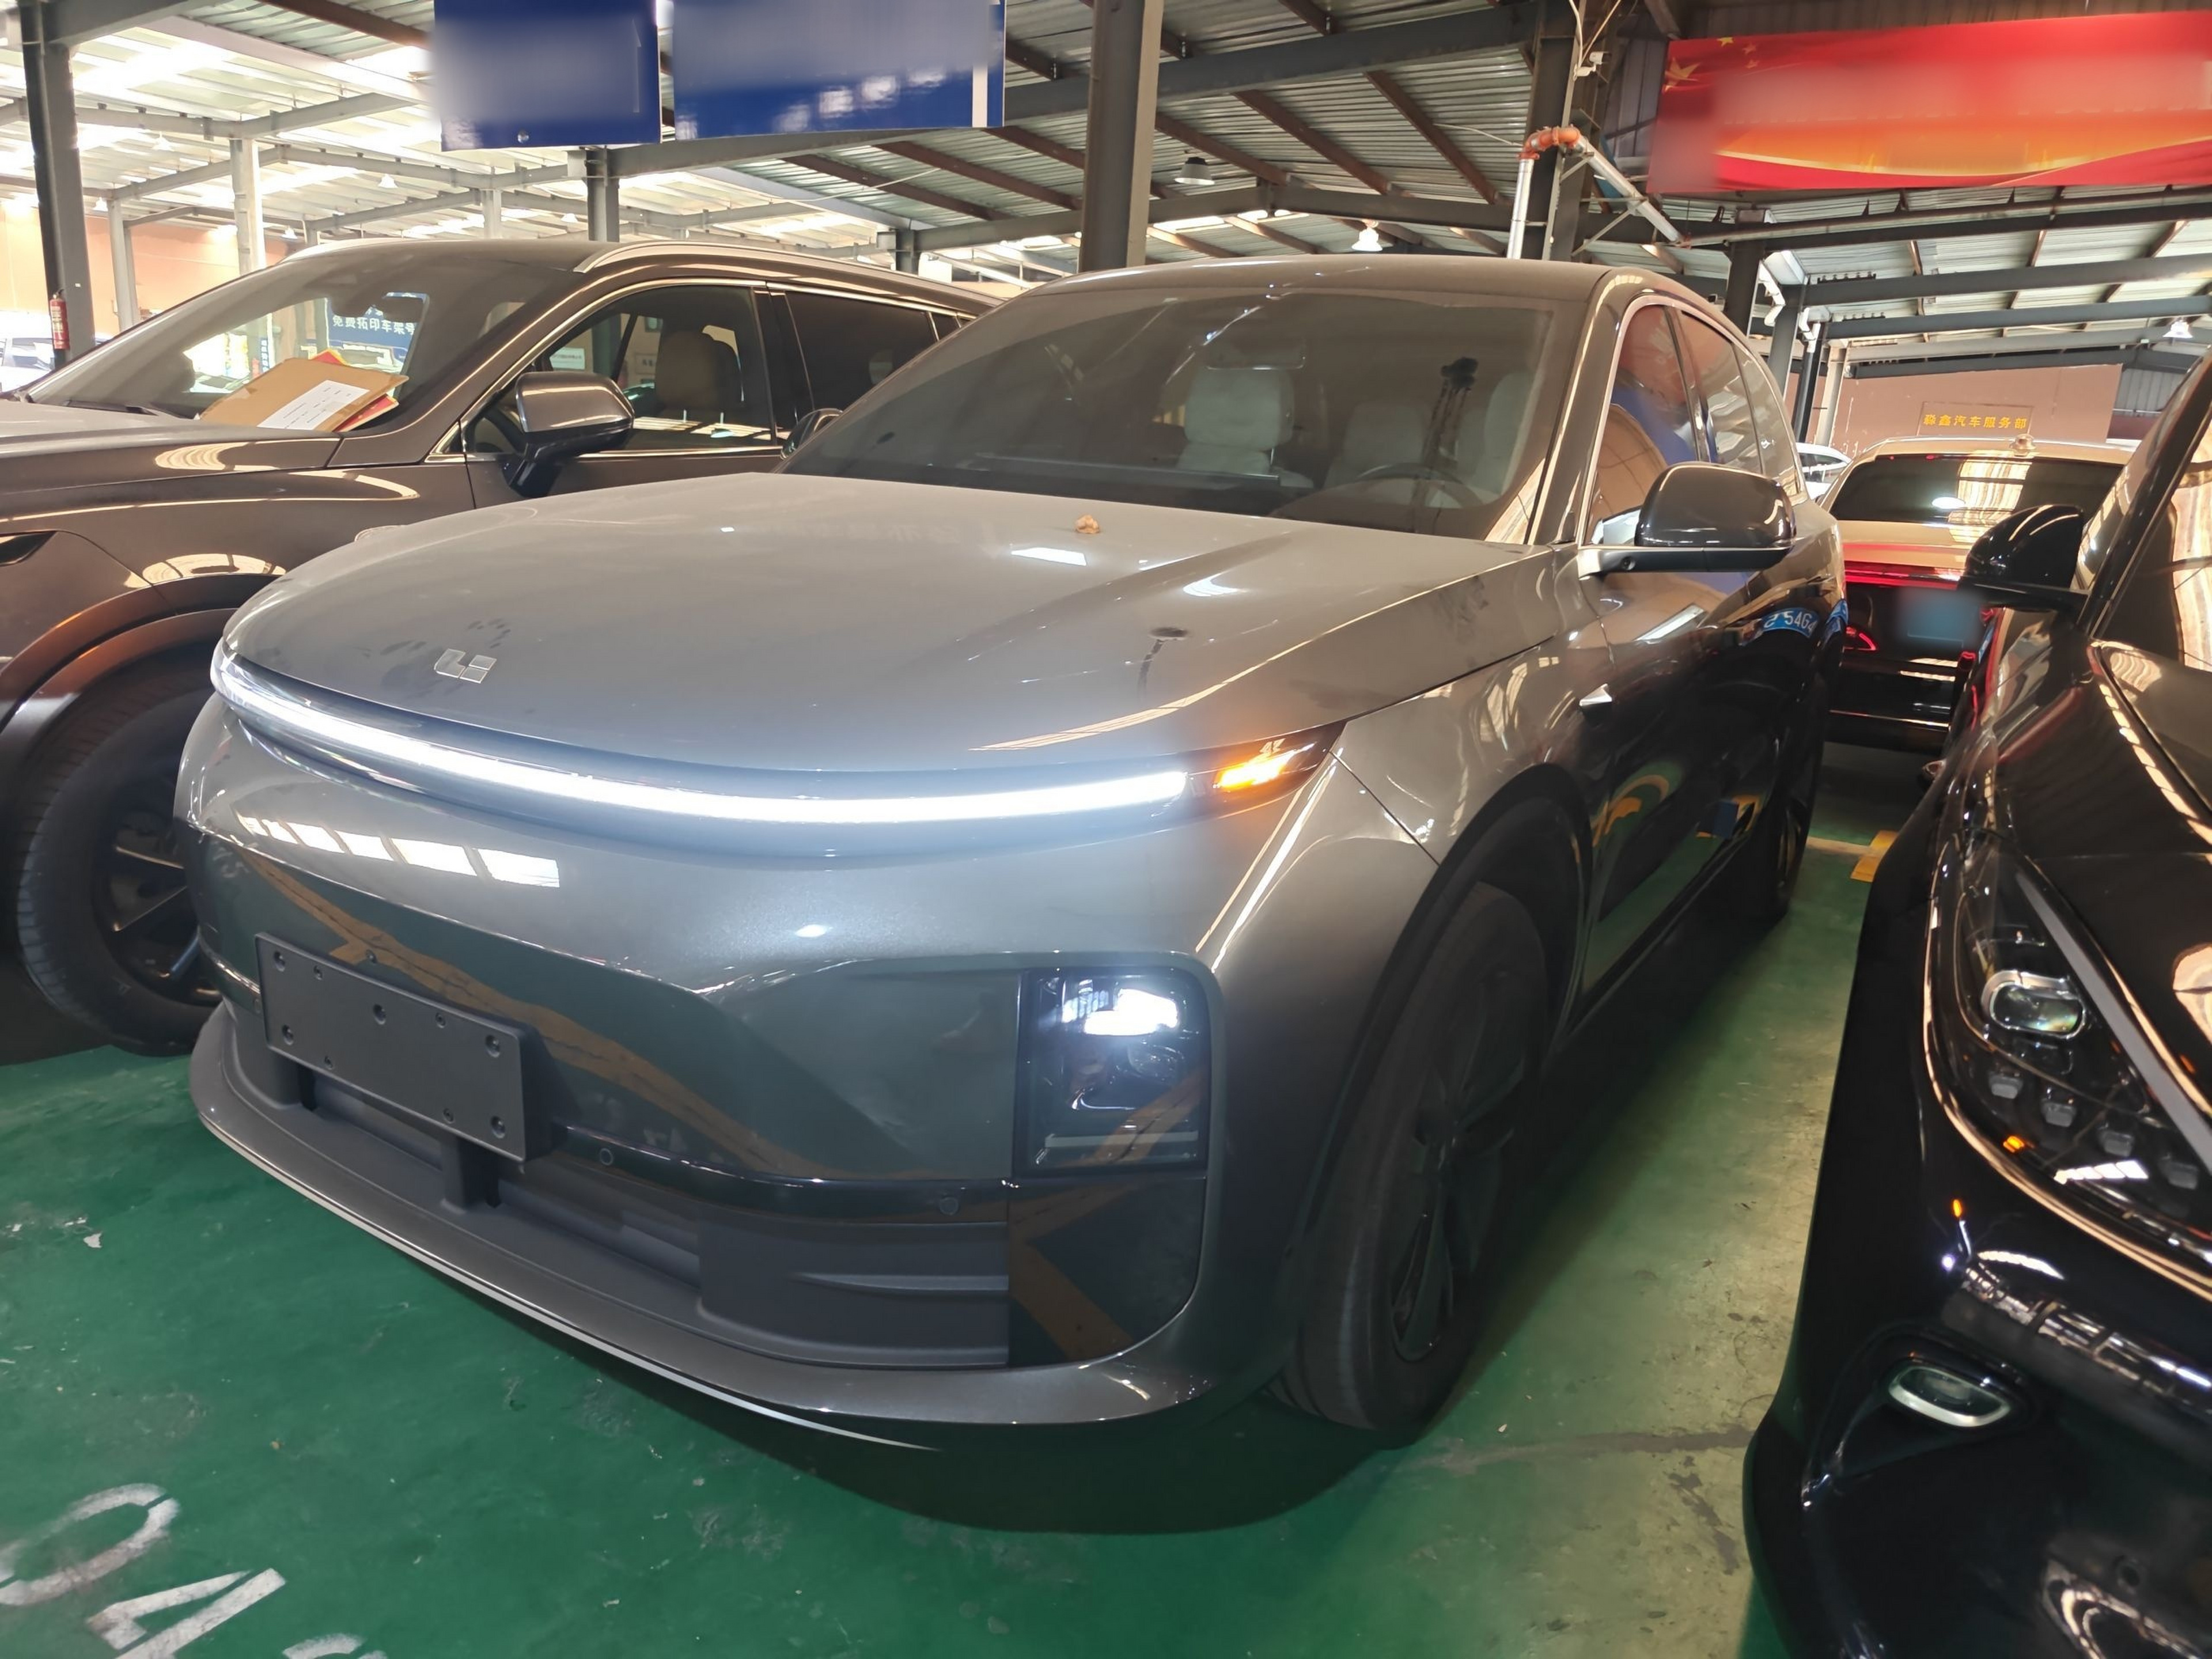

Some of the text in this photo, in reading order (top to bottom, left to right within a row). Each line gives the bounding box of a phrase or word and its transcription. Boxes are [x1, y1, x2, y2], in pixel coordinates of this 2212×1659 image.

[332, 315, 415, 335] 免费拓印车架号
